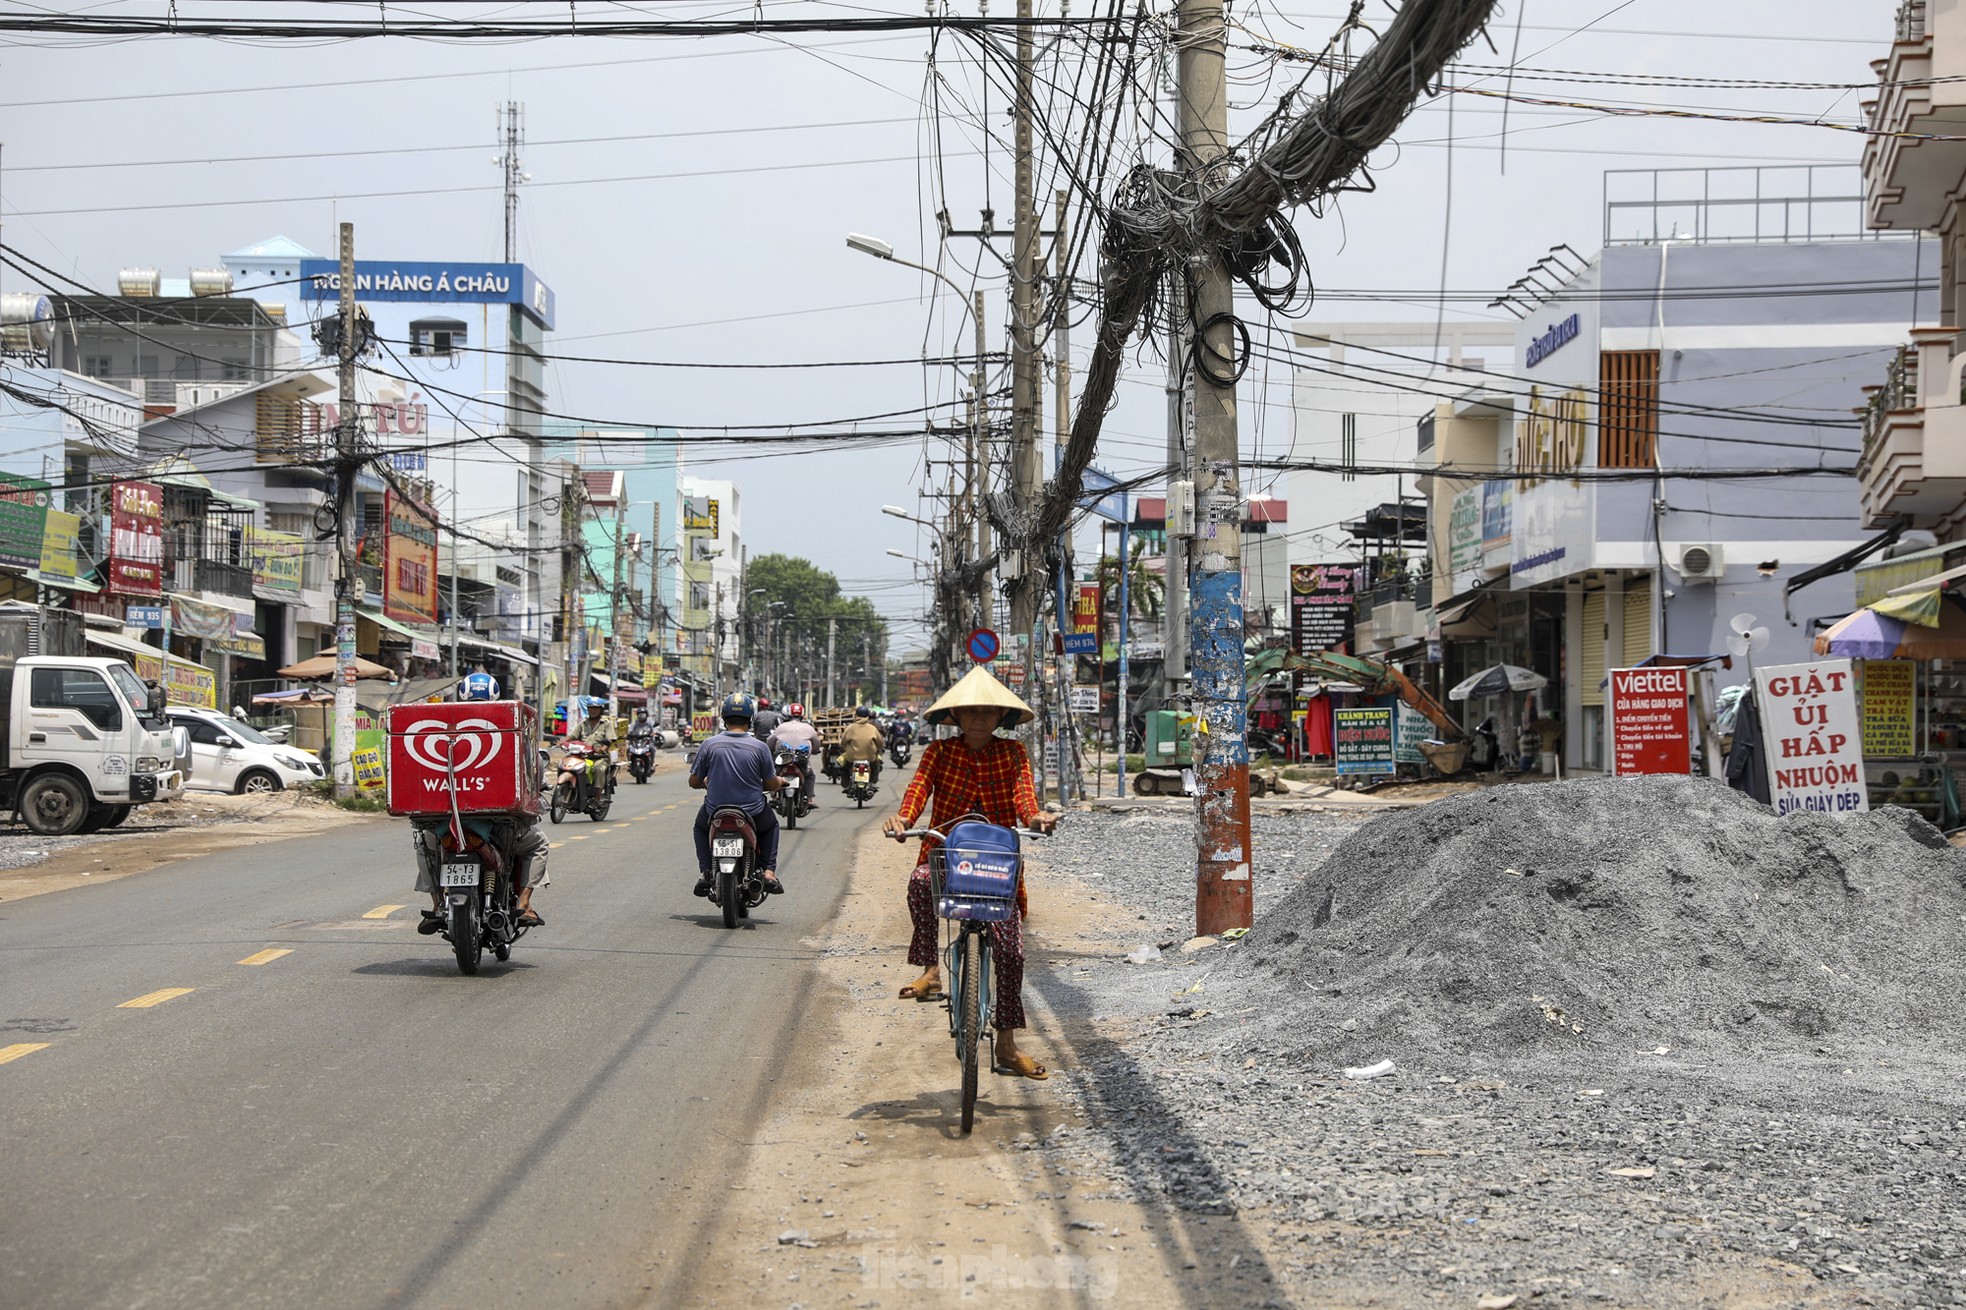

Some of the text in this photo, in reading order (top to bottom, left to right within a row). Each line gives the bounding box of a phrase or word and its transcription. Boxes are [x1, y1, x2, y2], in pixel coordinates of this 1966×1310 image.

[313, 270, 510, 294] NGN HÀNG Á CHÂU
[147, 611, 160, 621] 935
[1082, 638, 1095, 648] 874
[1616, 671, 1684, 693] viettel
[1768, 668, 1847, 698] GIẶT
[1616, 696, 1684, 711] CỬA HÀNG GIAO DỊCH
[1792, 697, 1829, 726] ỦI
[1338, 711, 1389, 720] KHÁNH TRANG
[1341, 719, 1358, 727] BÁN
[1338, 725, 1390, 743] ĐIỆN NƯỚC
[1780, 726, 1847, 758] HẤP
[1775, 759, 1858, 790] NHUỘM
[423, 777, 485, 792] WALL'S
[1837, 787, 1860, 812] DÉP
[447, 864, 474, 874] 54-Y3
[446, 875, 474, 885] 1865
